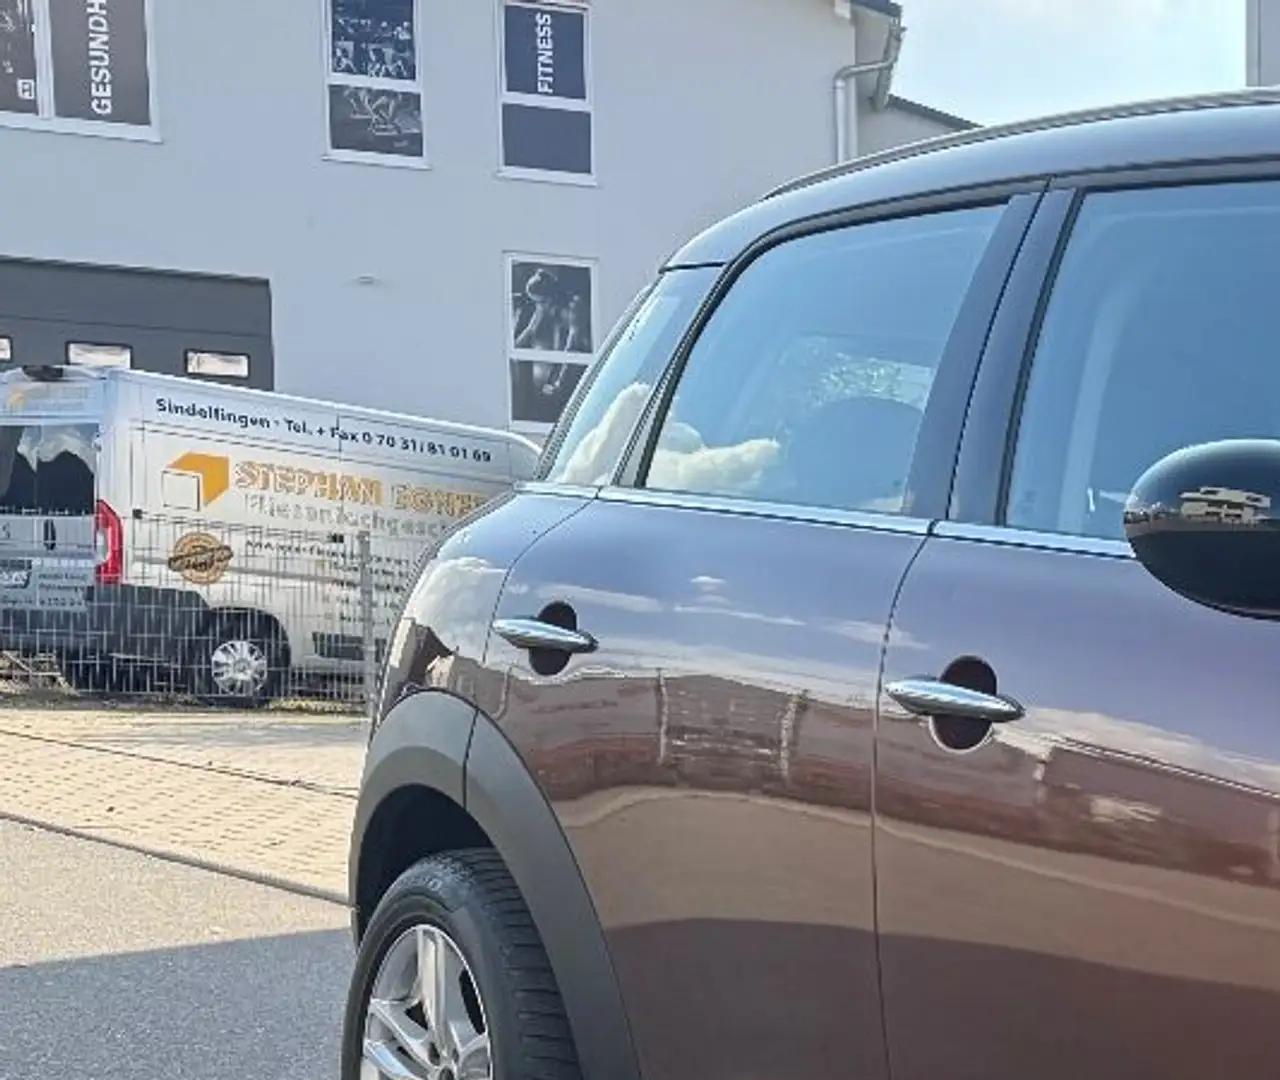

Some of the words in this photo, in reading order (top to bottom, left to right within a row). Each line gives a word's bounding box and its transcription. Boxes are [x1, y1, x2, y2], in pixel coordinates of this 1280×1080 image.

[536, 12, 553, 93] FITNESS
[156, 398, 271, 429] Sindelfingen
[330, 427, 359, 443] Fax
[376, 434, 396, 449] 70
[234, 460, 384, 508] STEPHAN
